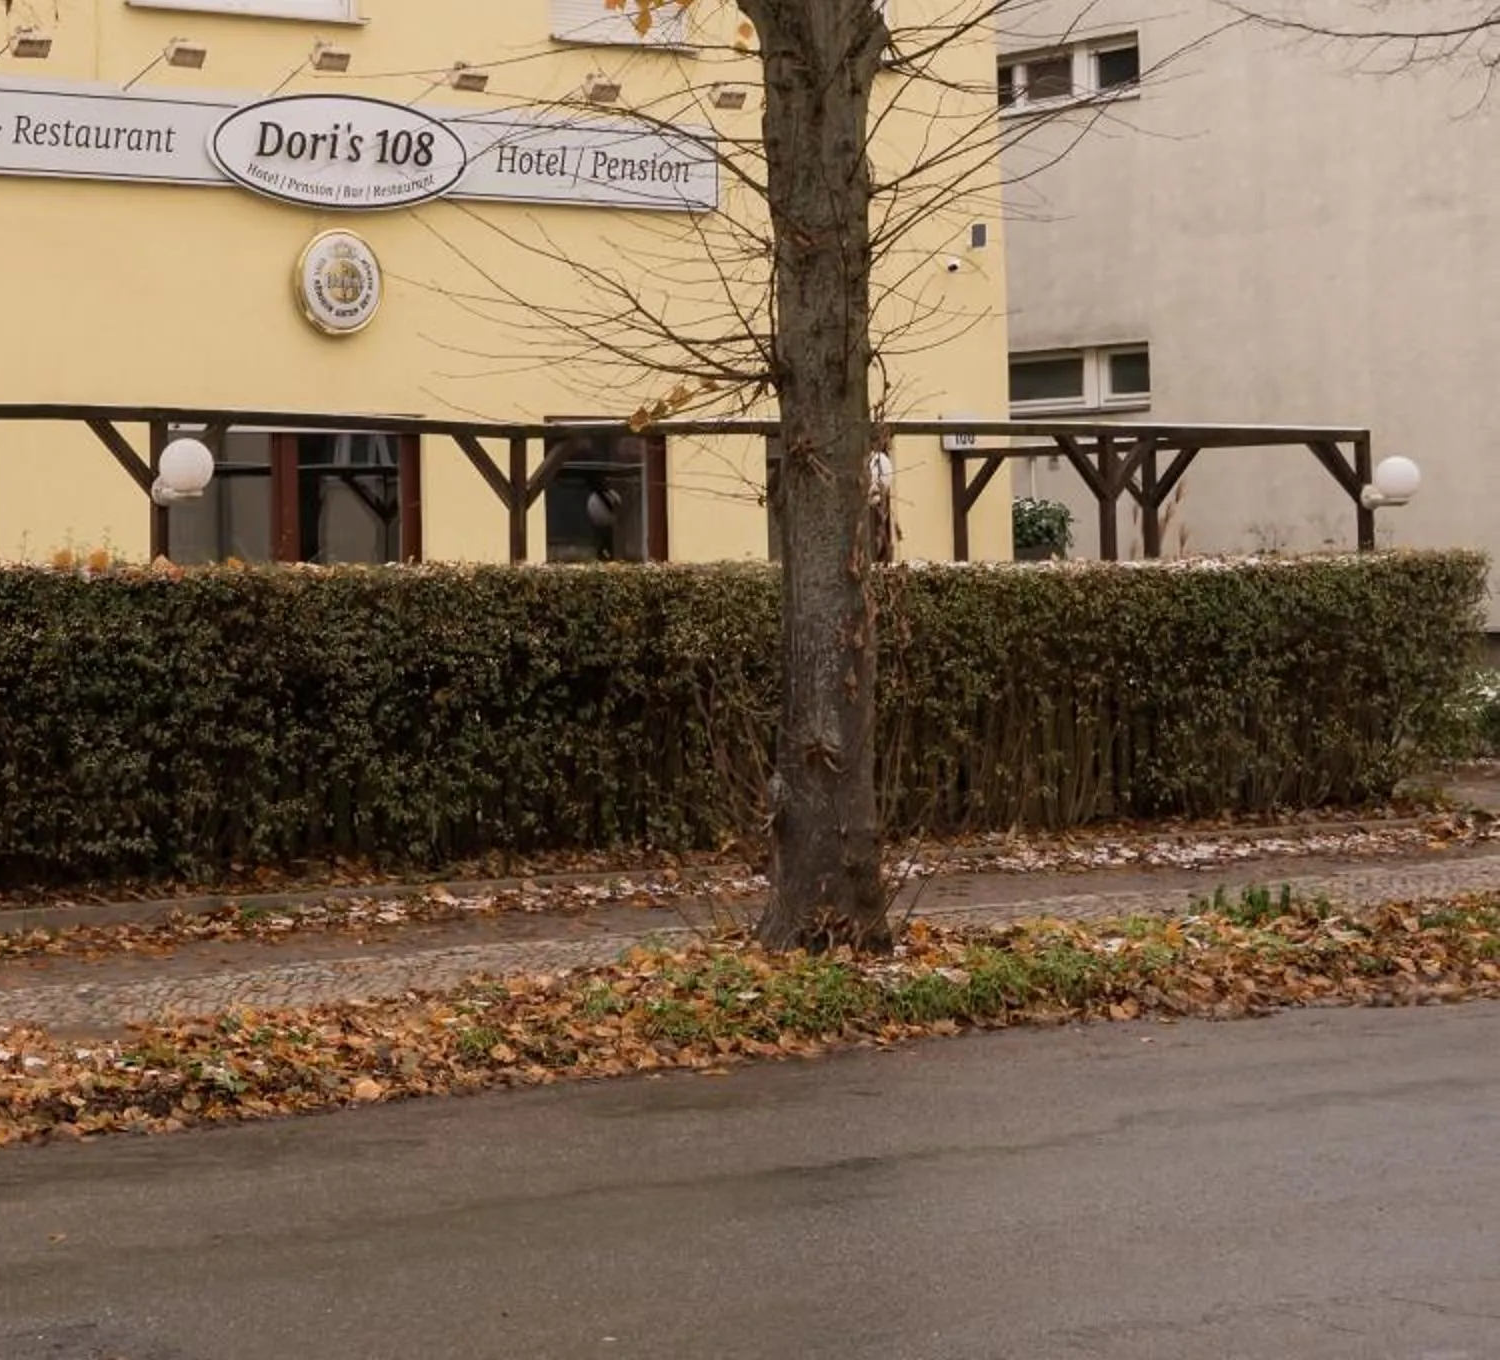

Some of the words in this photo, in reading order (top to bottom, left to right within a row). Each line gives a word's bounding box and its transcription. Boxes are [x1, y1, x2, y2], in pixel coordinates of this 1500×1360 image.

[12, 115, 177, 153] Restaurant
[255, 121, 364, 163] Dori's
[375, 129, 435, 167] 108
[246, 163, 280, 185] Hotel
[286, 177, 333, 197] Pension
[343, 185, 364, 197] Bar
[373, 173, 435, 197] Restaurant
[496, 144, 567, 176] Hotel
[589, 150, 690, 183] Pension
